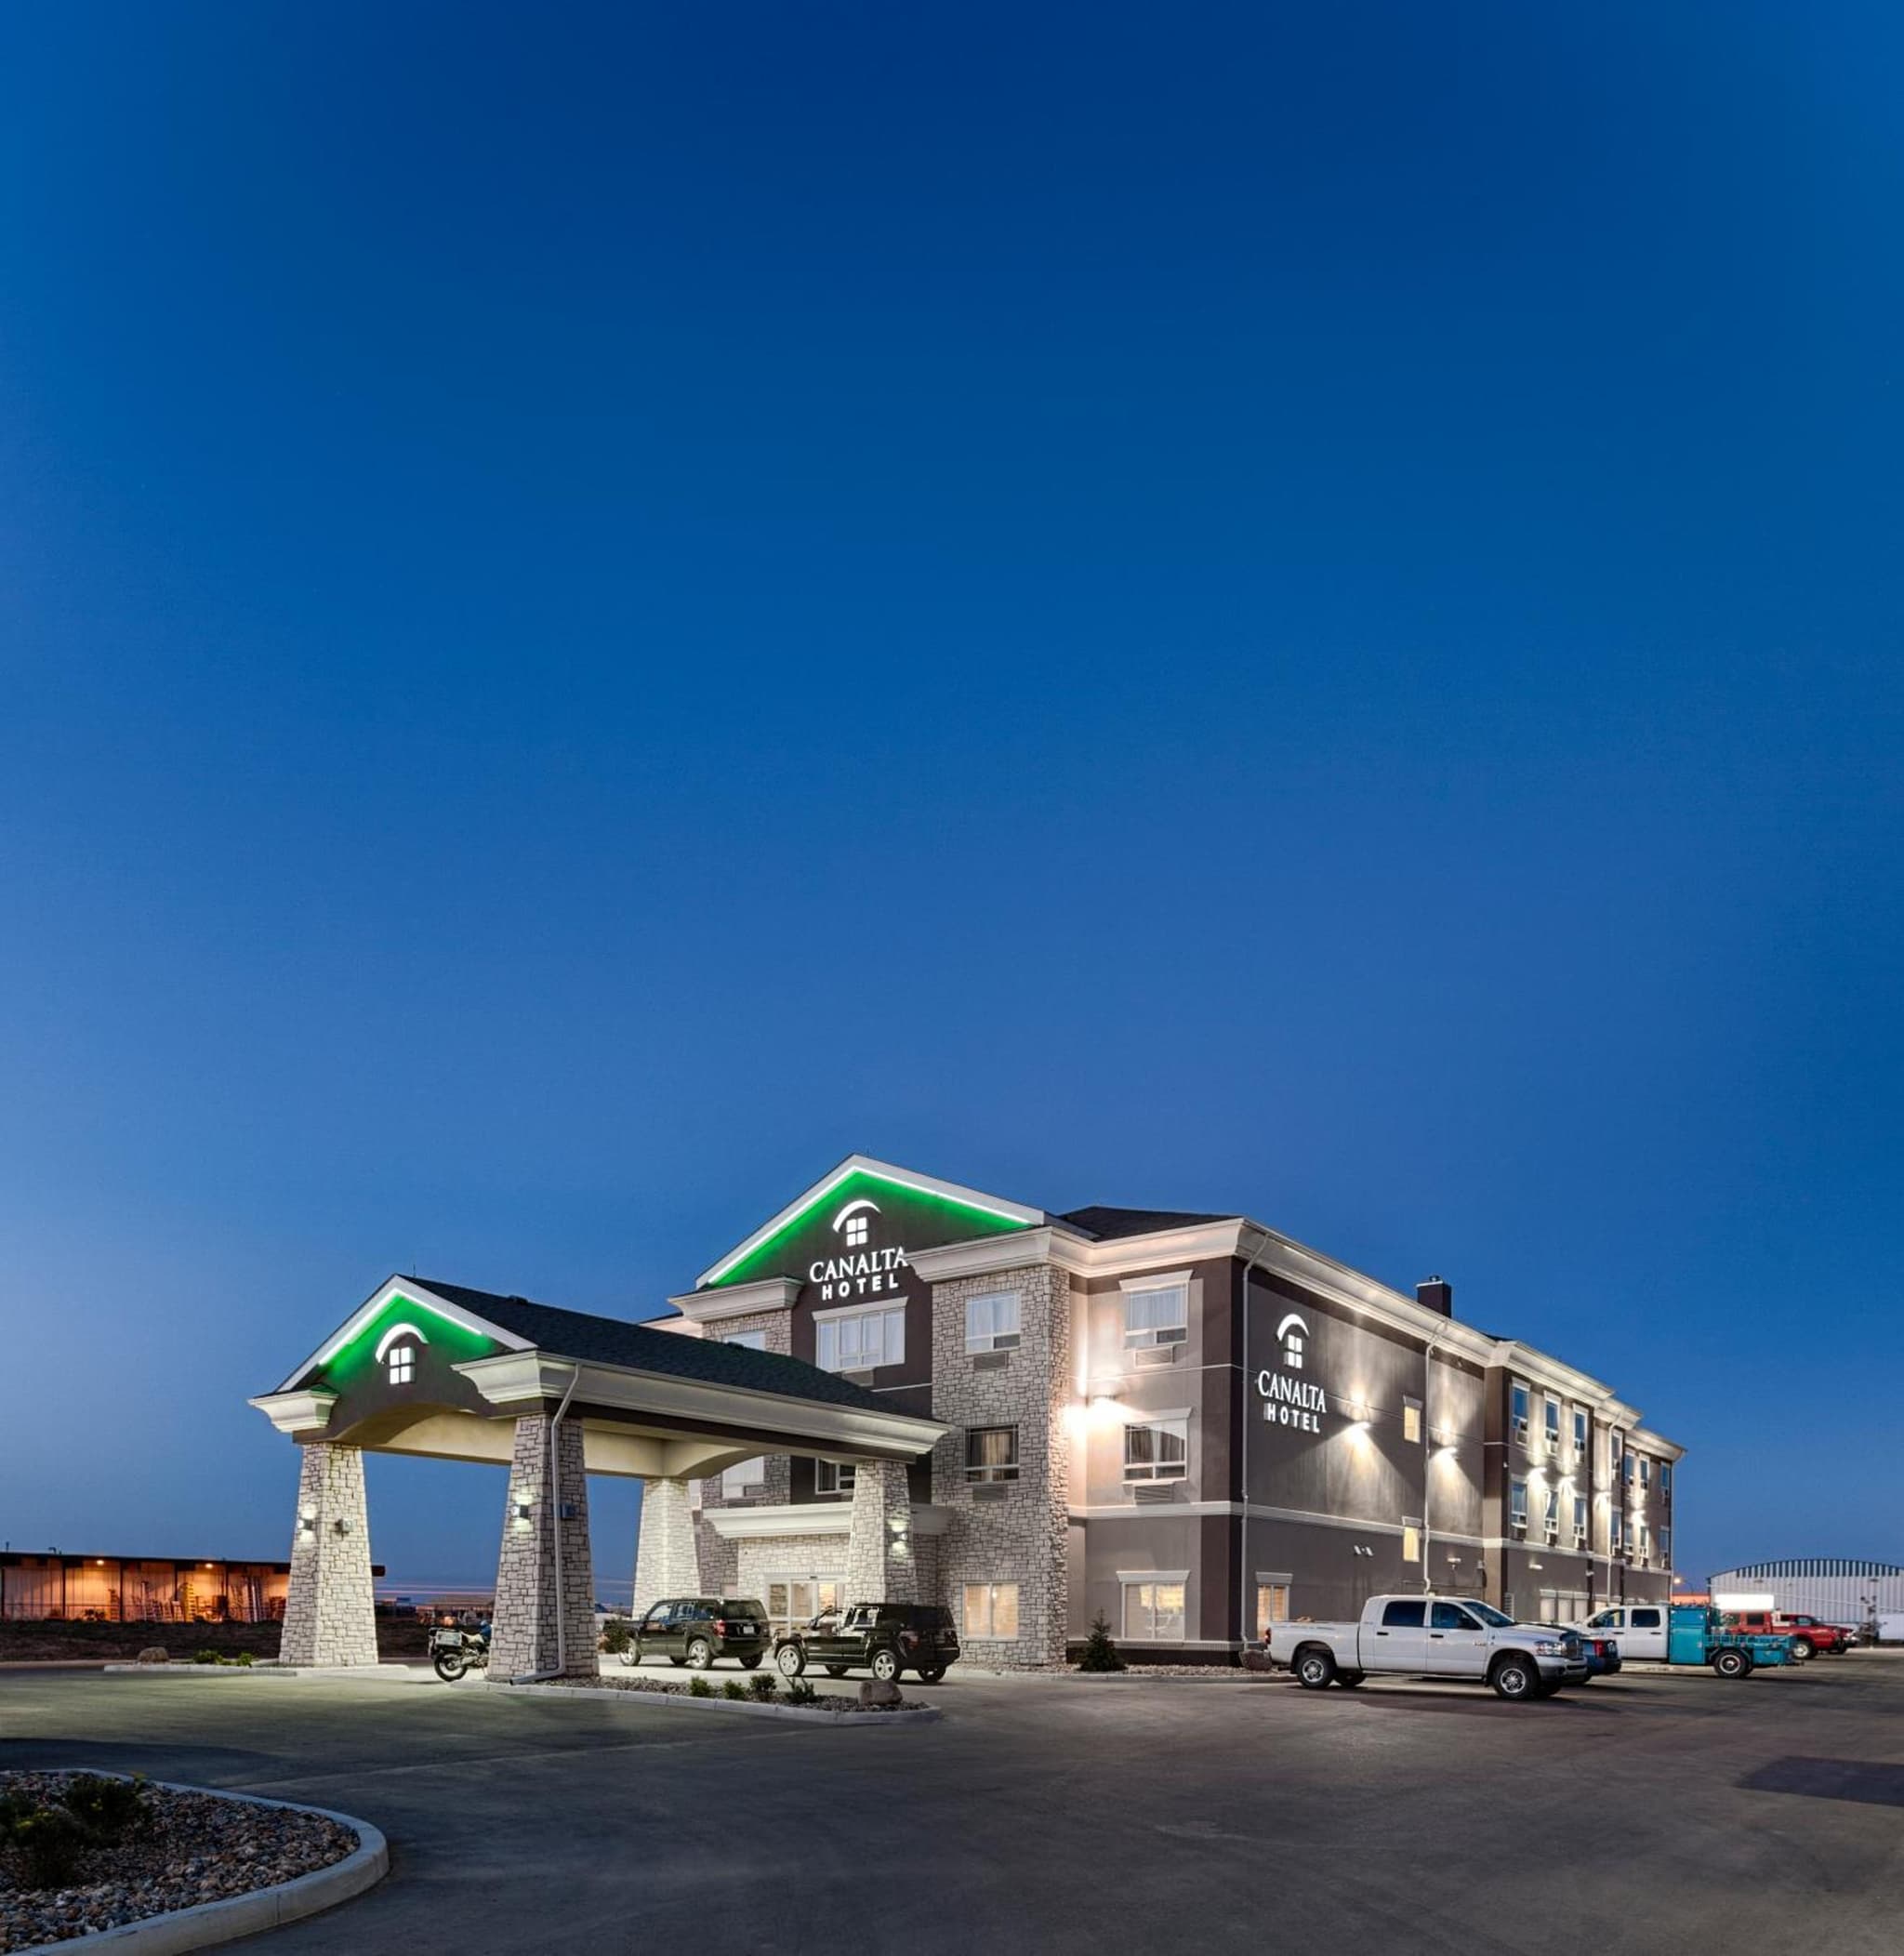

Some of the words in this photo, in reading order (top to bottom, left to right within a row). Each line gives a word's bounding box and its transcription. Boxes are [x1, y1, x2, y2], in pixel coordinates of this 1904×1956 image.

[809, 1246, 908, 1283] CANALTA
[822, 1273, 899, 1301] HOTEL
[1258, 1369, 1327, 1413] CANALTA
[1265, 1402, 1320, 1434] HOTEL
